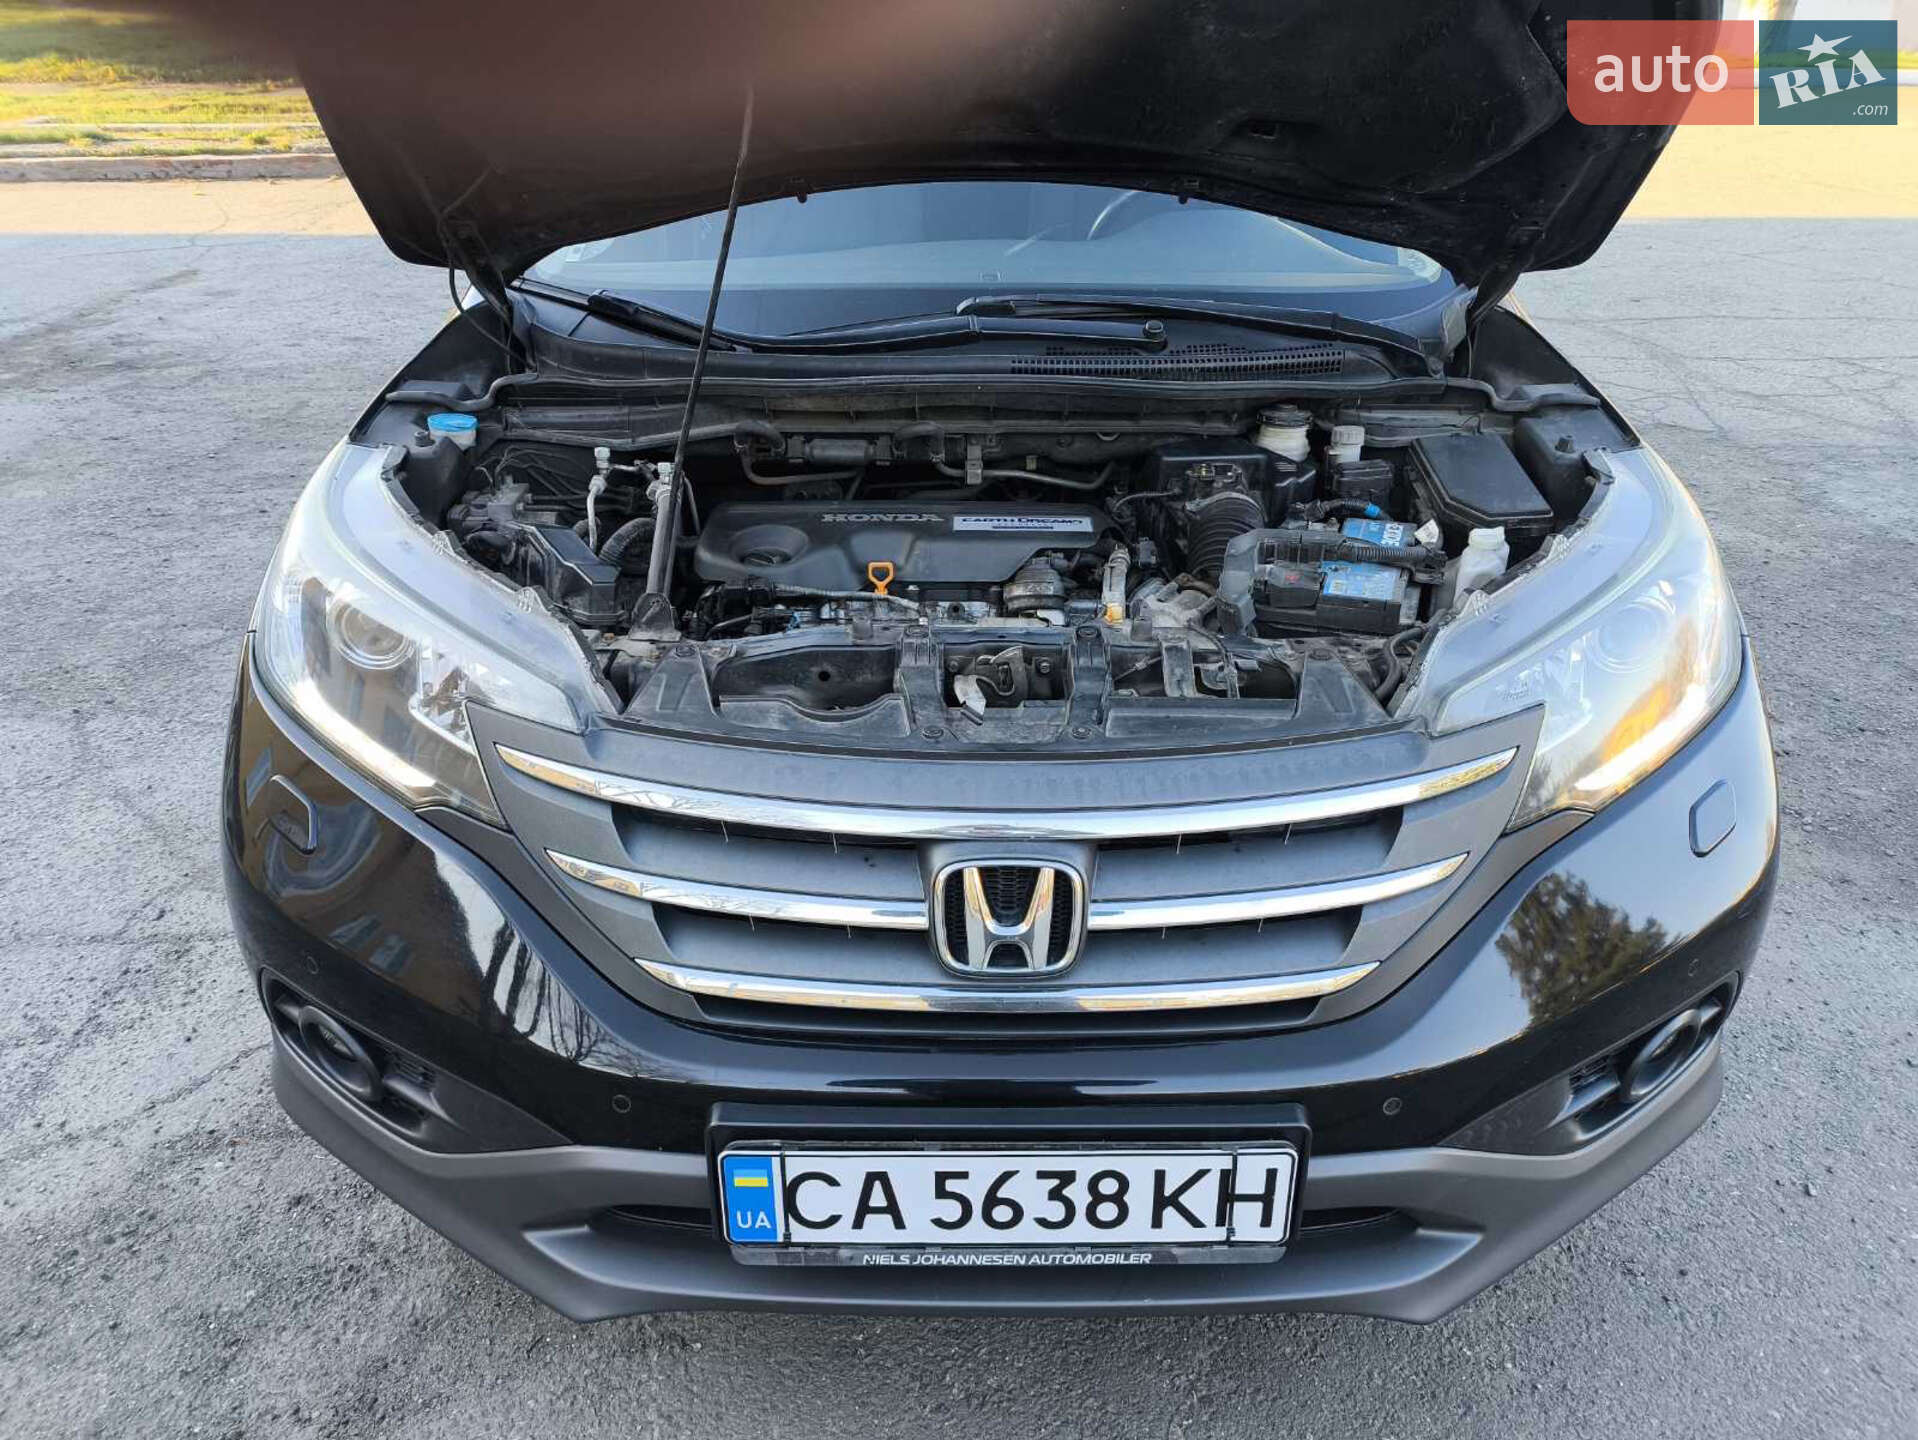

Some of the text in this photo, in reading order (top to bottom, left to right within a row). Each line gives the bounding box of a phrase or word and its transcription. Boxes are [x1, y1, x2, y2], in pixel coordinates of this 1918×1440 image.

[821, 513, 945, 522] HONDA
[787, 1168, 1278, 1230] CA 5638 KH
[736, 1211, 772, 1229] UA
[862, 1253, 1153, 1265] NIELS JOHANNESEN AUTOMOBILER
